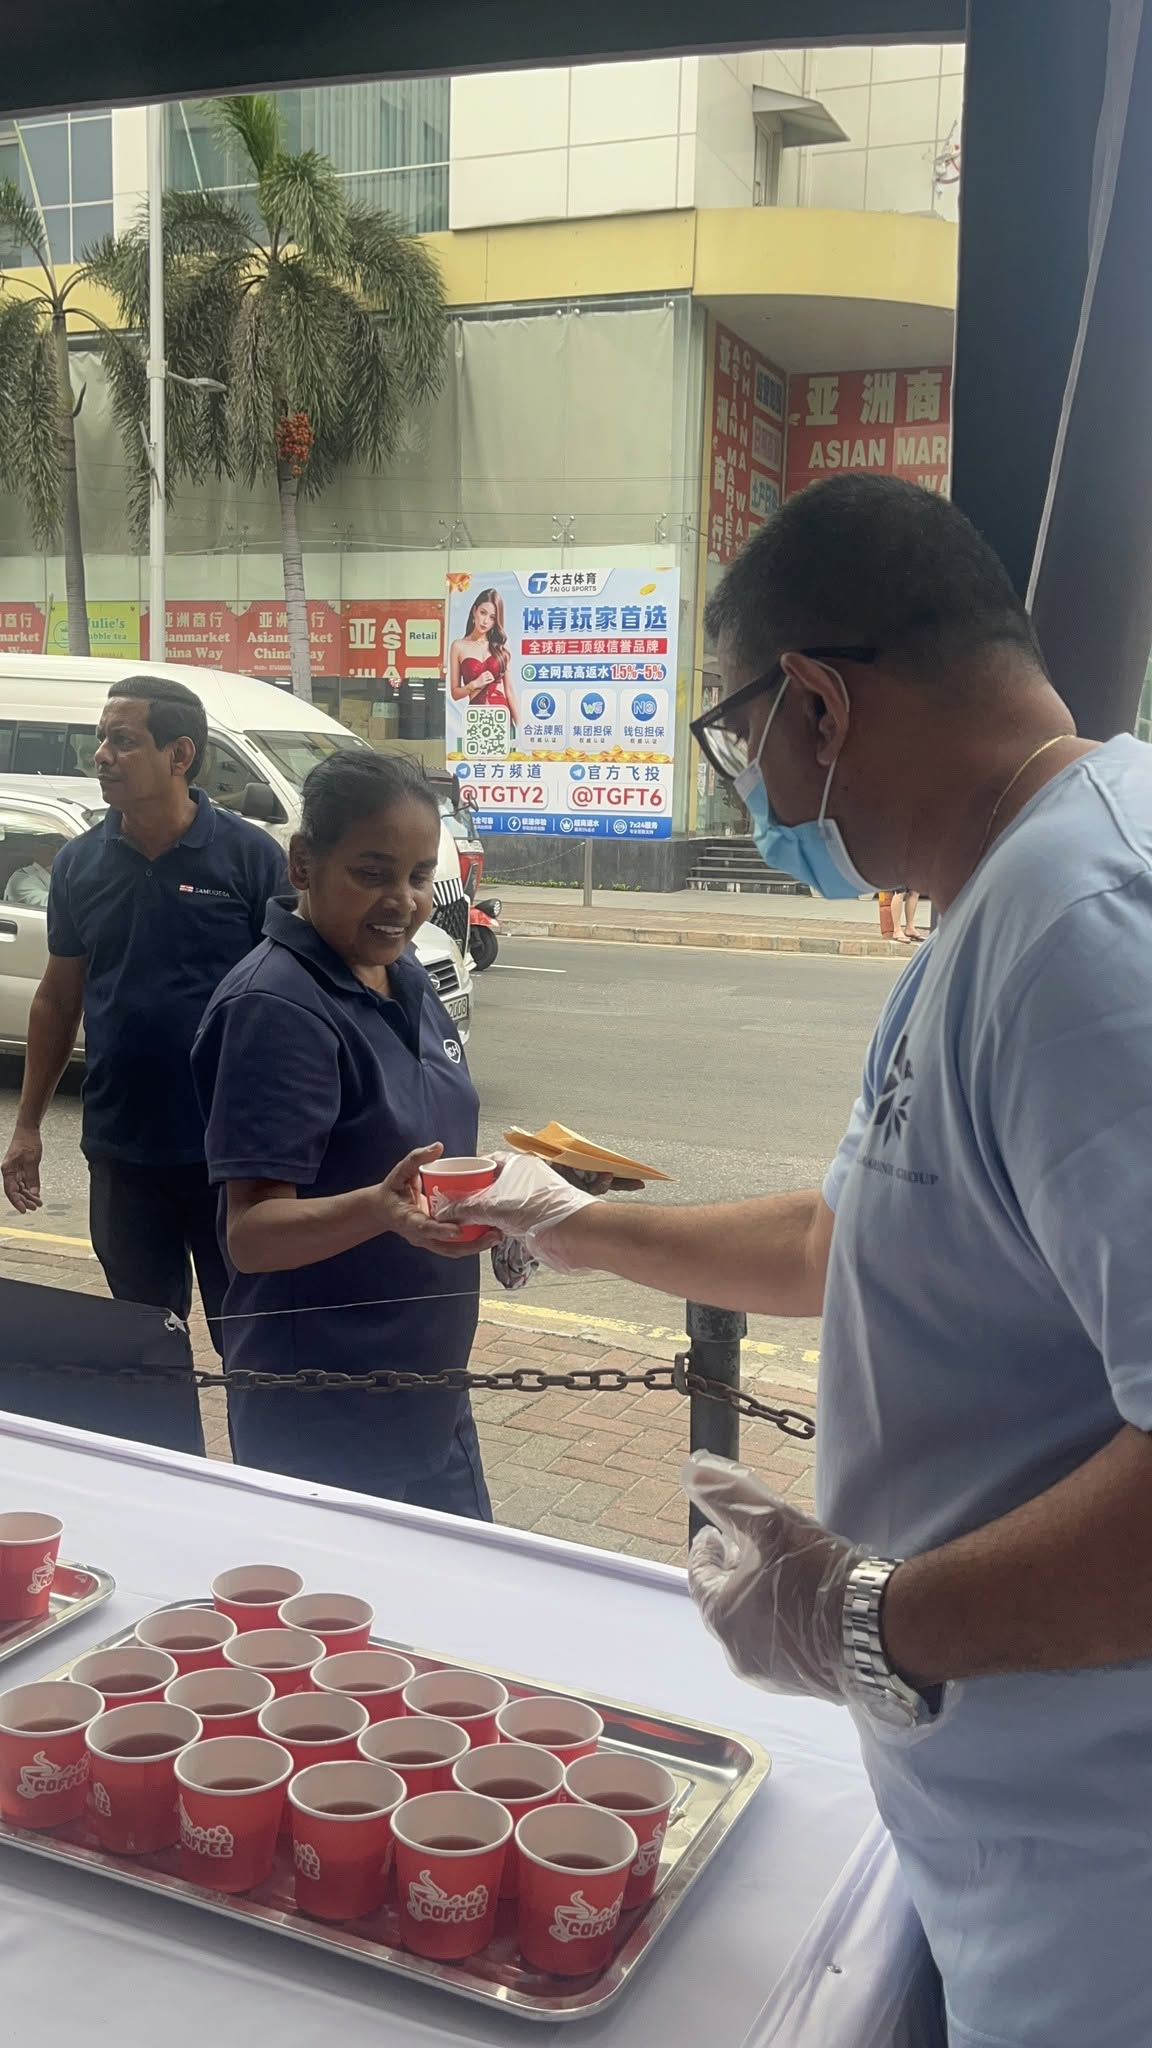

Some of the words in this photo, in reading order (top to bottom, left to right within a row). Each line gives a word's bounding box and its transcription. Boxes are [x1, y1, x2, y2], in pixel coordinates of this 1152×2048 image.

[728, 345, 740, 438] ASIAN
[739, 352, 751, 473] CHINA
[808, 438, 887, 469] ASIAN
[724, 447, 737, 557] MARKET
[550, 572, 597, 586] 太古体育
[571, 585, 597, 593] SPORTS
[0, 612, 32, 629] 商行
[259, 612, 325, 628] 亚洲行
[523, 605, 667, 633] 体育玩家首选
[247, 631, 334, 643] Asianmket
[409, 631, 437, 640] Retail
[165, 646, 192, 658] hina
[195, 647, 224, 661] Way
[528, 639, 659, 655] 全球前三顶级信誉品牌
[310, 650, 325, 661] ay
[538, 665, 609, 680] 全网最高返水
[523, 725, 564, 736] 合法牌照
[573, 725, 613, 737] 集团担保
[624, 726, 665, 738] 钱包担保
[474, 764, 542, 779] 官方频道
[588, 765, 660, 781] 官方飞投
[459, 785, 544, 804] @TGTY2
[572, 786, 662, 807] @TGFT6
[184, 1830, 233, 1857] OFFEE
[419, 1901, 488, 1922] COFFEE
